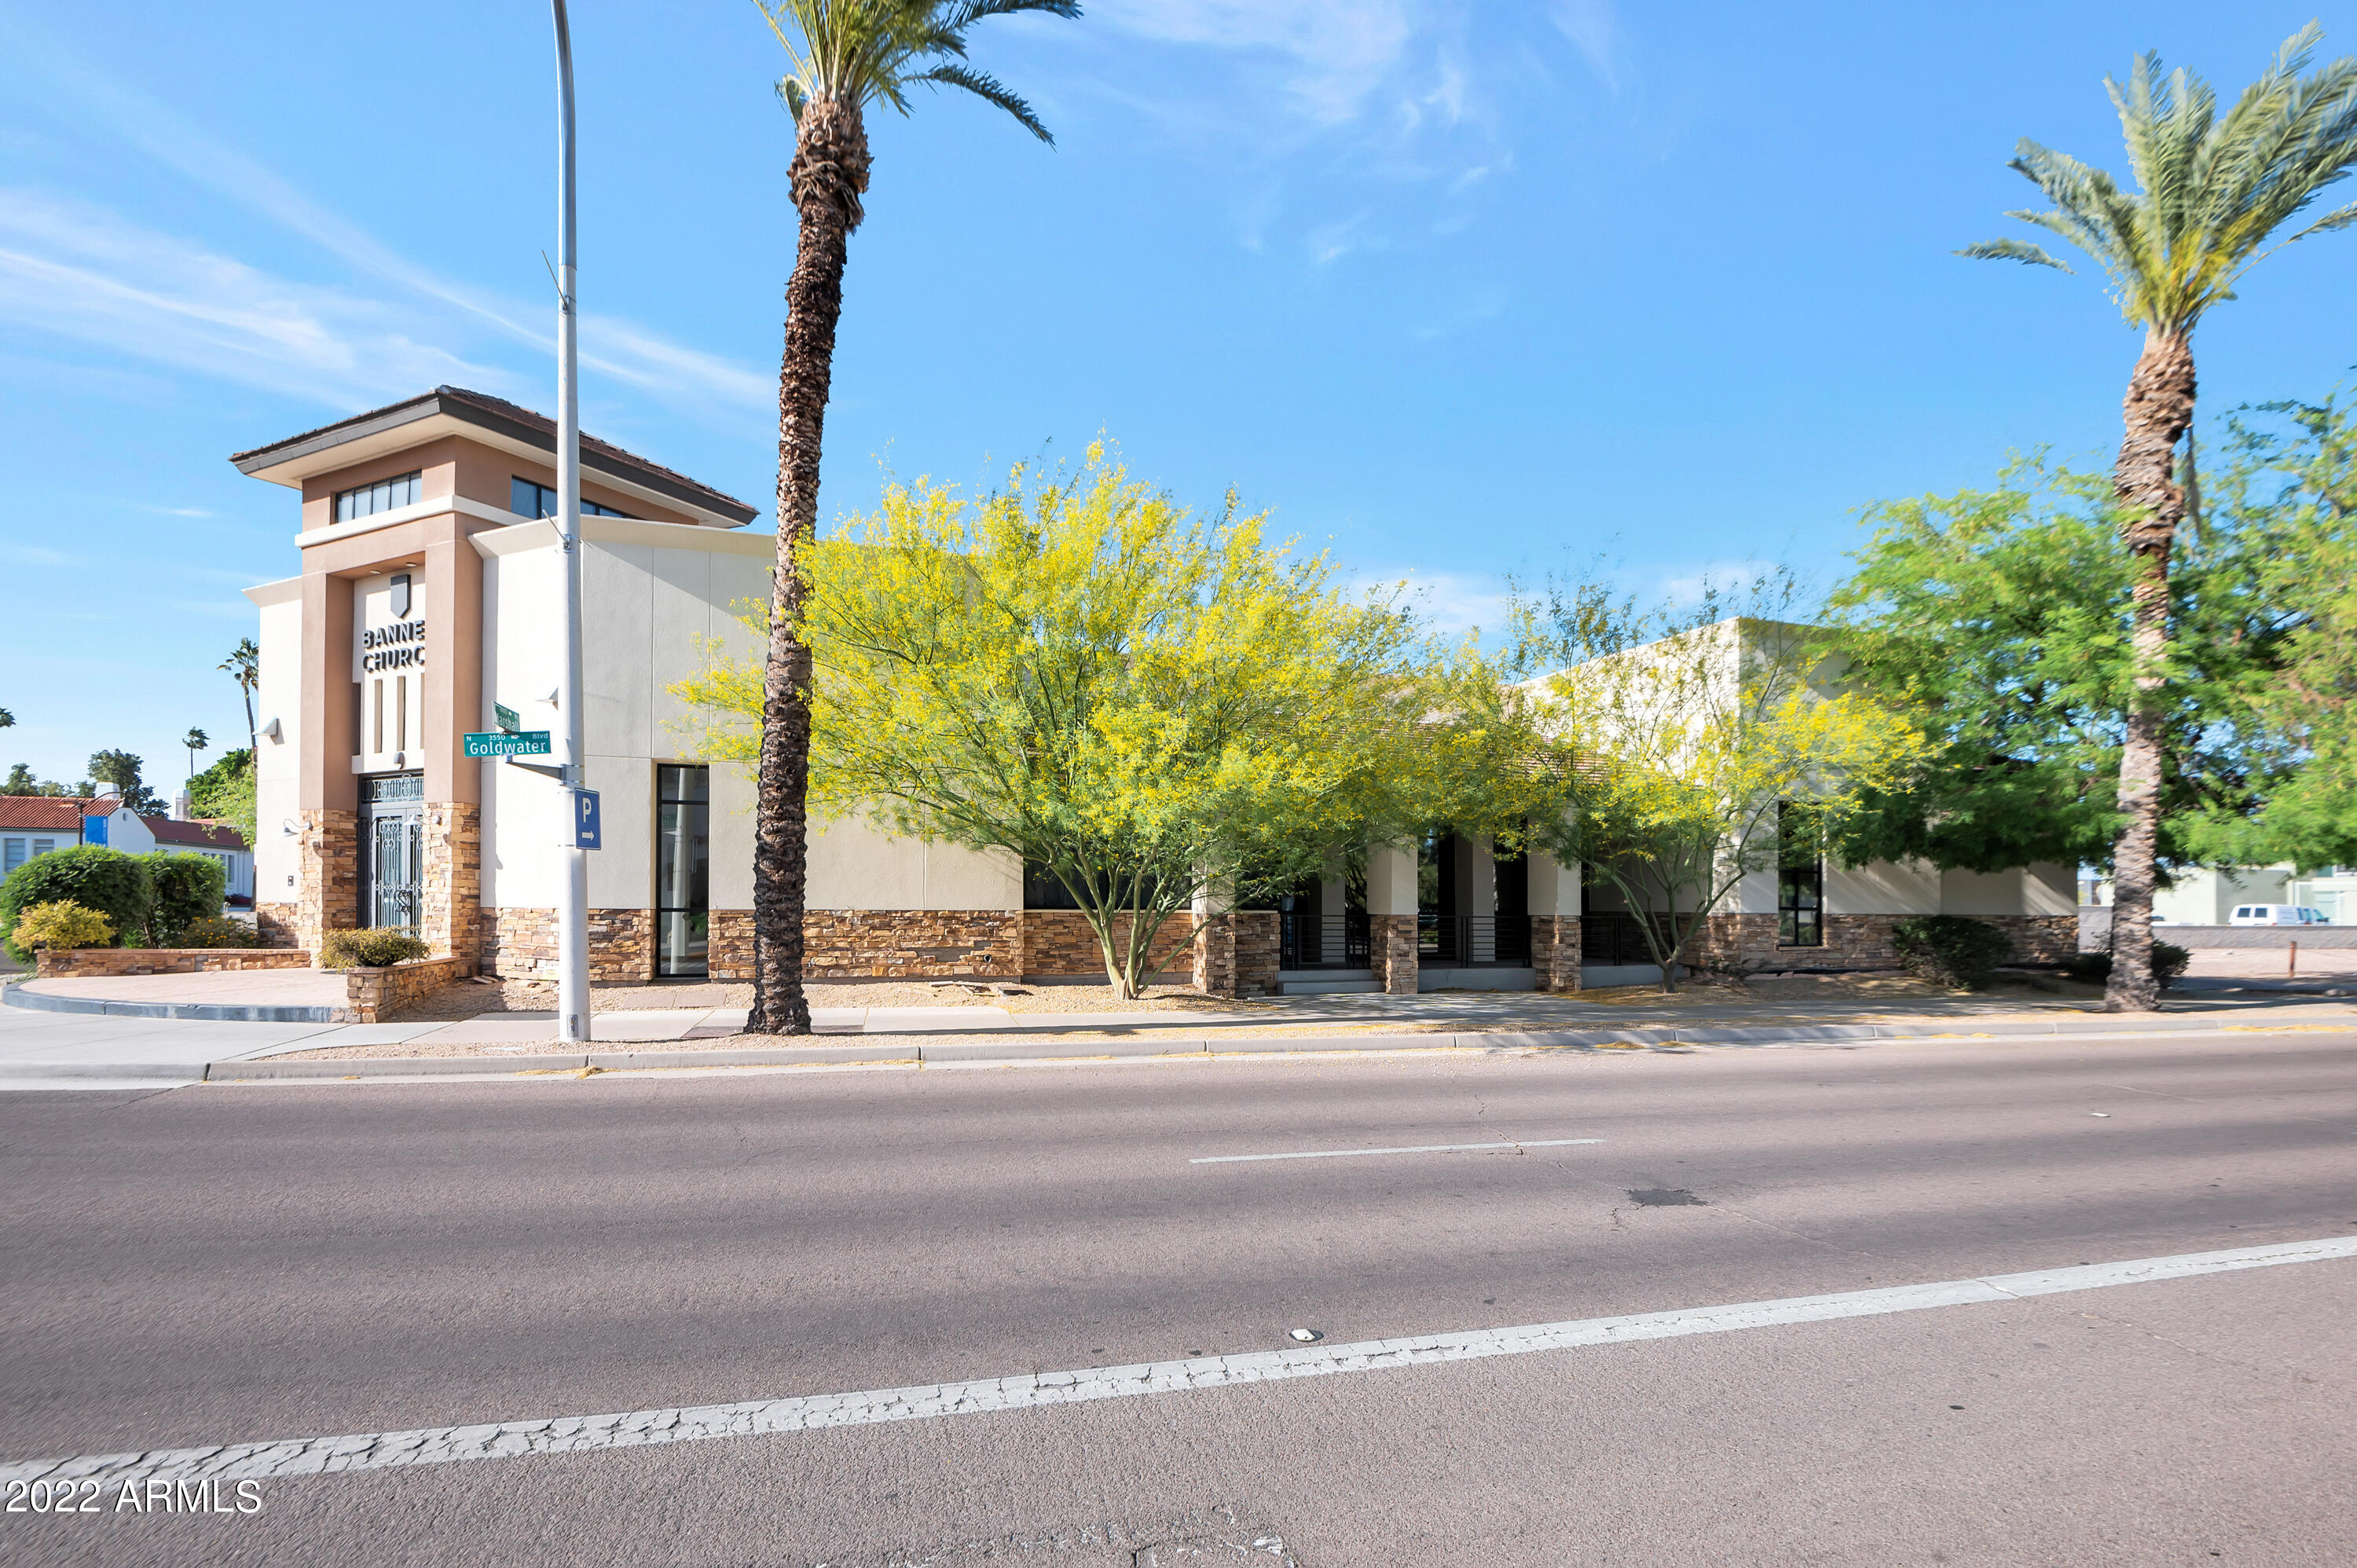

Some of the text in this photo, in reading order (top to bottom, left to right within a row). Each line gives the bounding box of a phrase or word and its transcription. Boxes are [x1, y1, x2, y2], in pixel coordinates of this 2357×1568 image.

[361, 620, 425, 650] BANNE
[362, 645, 425, 673] CHURC
[470, 741, 546, 754] Goldwater
[583, 797, 592, 822] P
